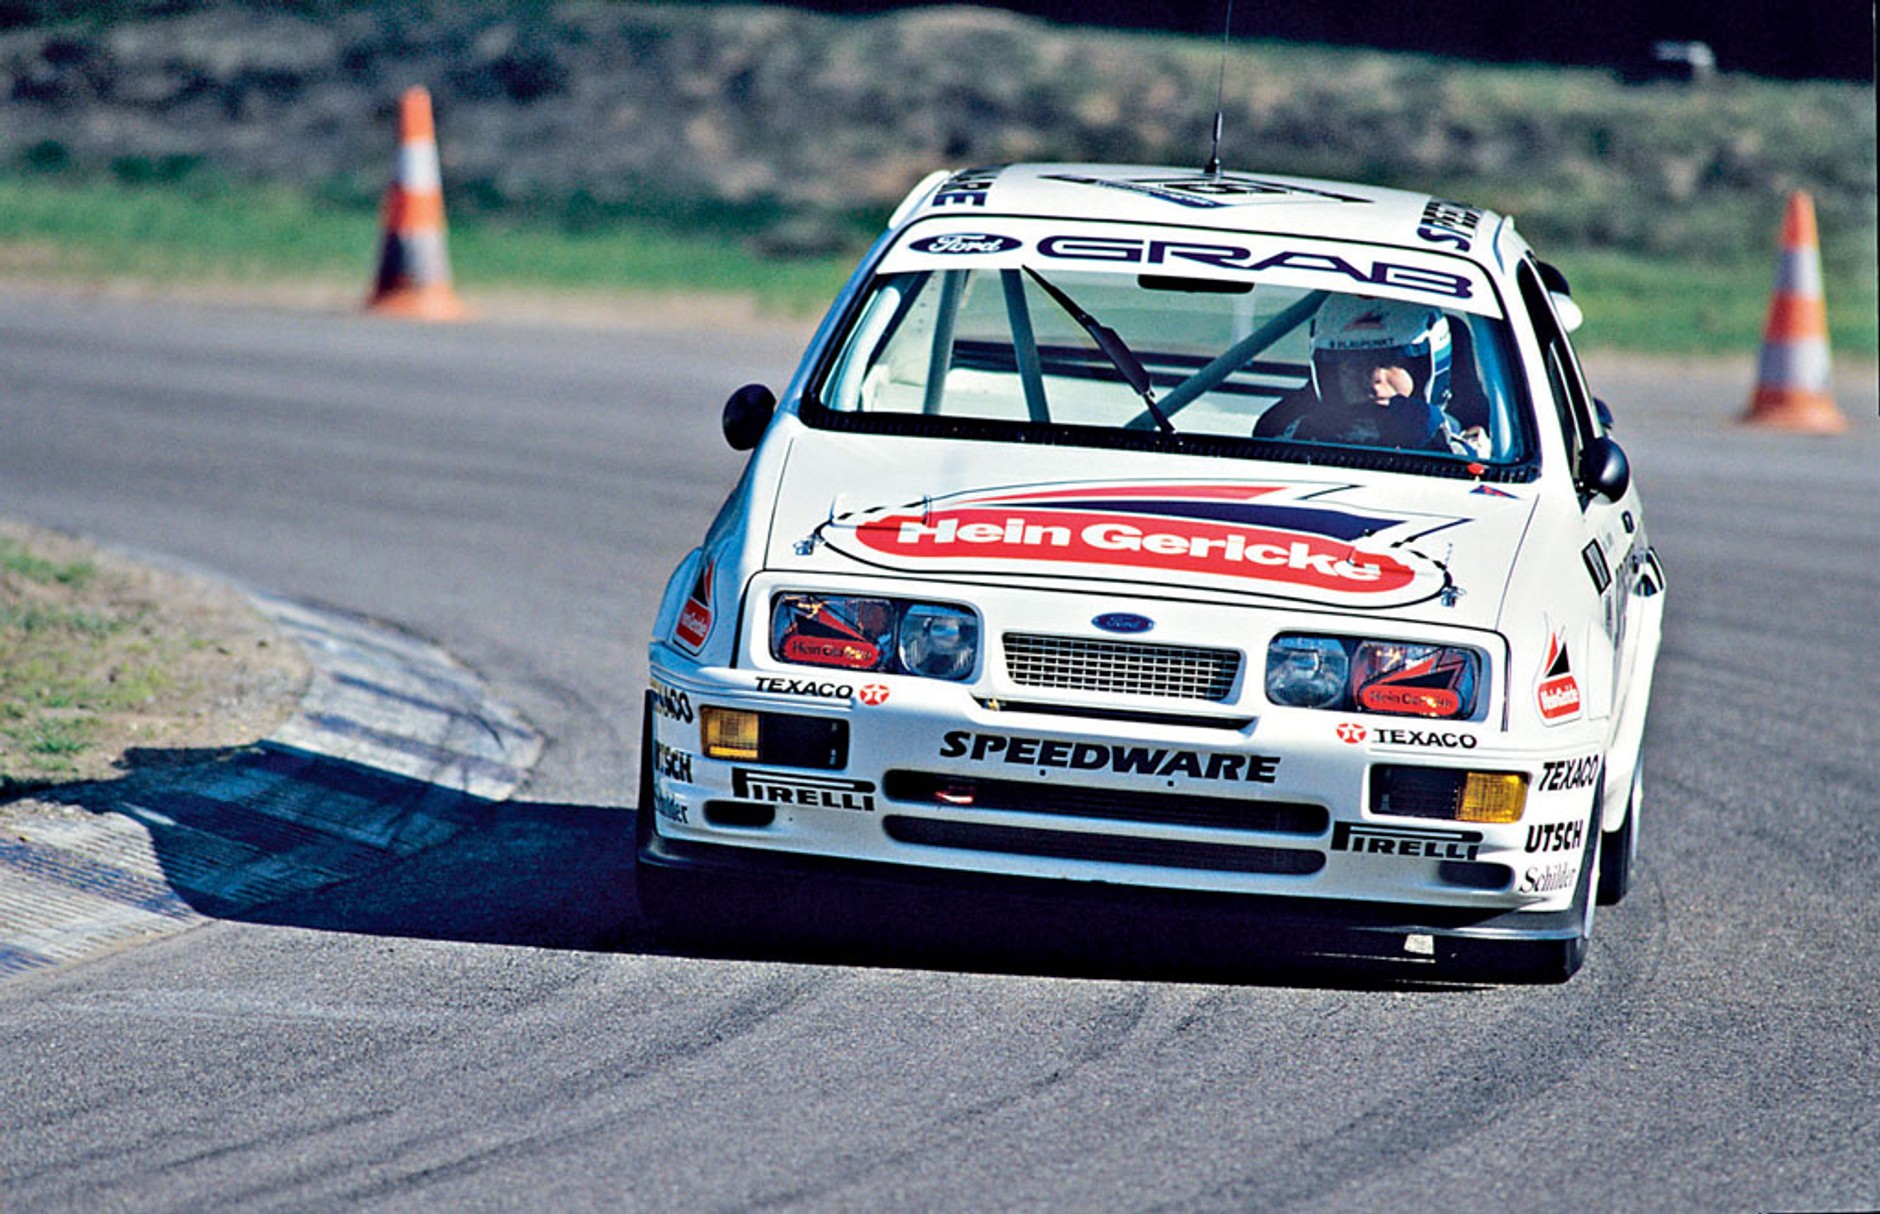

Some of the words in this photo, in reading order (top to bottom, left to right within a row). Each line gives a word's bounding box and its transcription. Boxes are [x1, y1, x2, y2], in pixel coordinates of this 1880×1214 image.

[927, 234, 1004, 254] Ford
[1036, 235, 1474, 299] GRAB
[897, 517, 1071, 547] Hein
[1081, 523, 1382, 582] Gericke
[755, 676, 853, 699] TEXACO
[940, 731, 1281, 783] SPEEDWARE
[1373, 728, 1477, 749] TEXACO
[732, 767, 876, 811] PIRELLI
[1538, 754, 1598, 791] TEXACO
[1331, 821, 1484, 861] PIRELLI
[1525, 820, 1583, 853] UTSCH
[1519, 862, 1576, 893] Schilder
